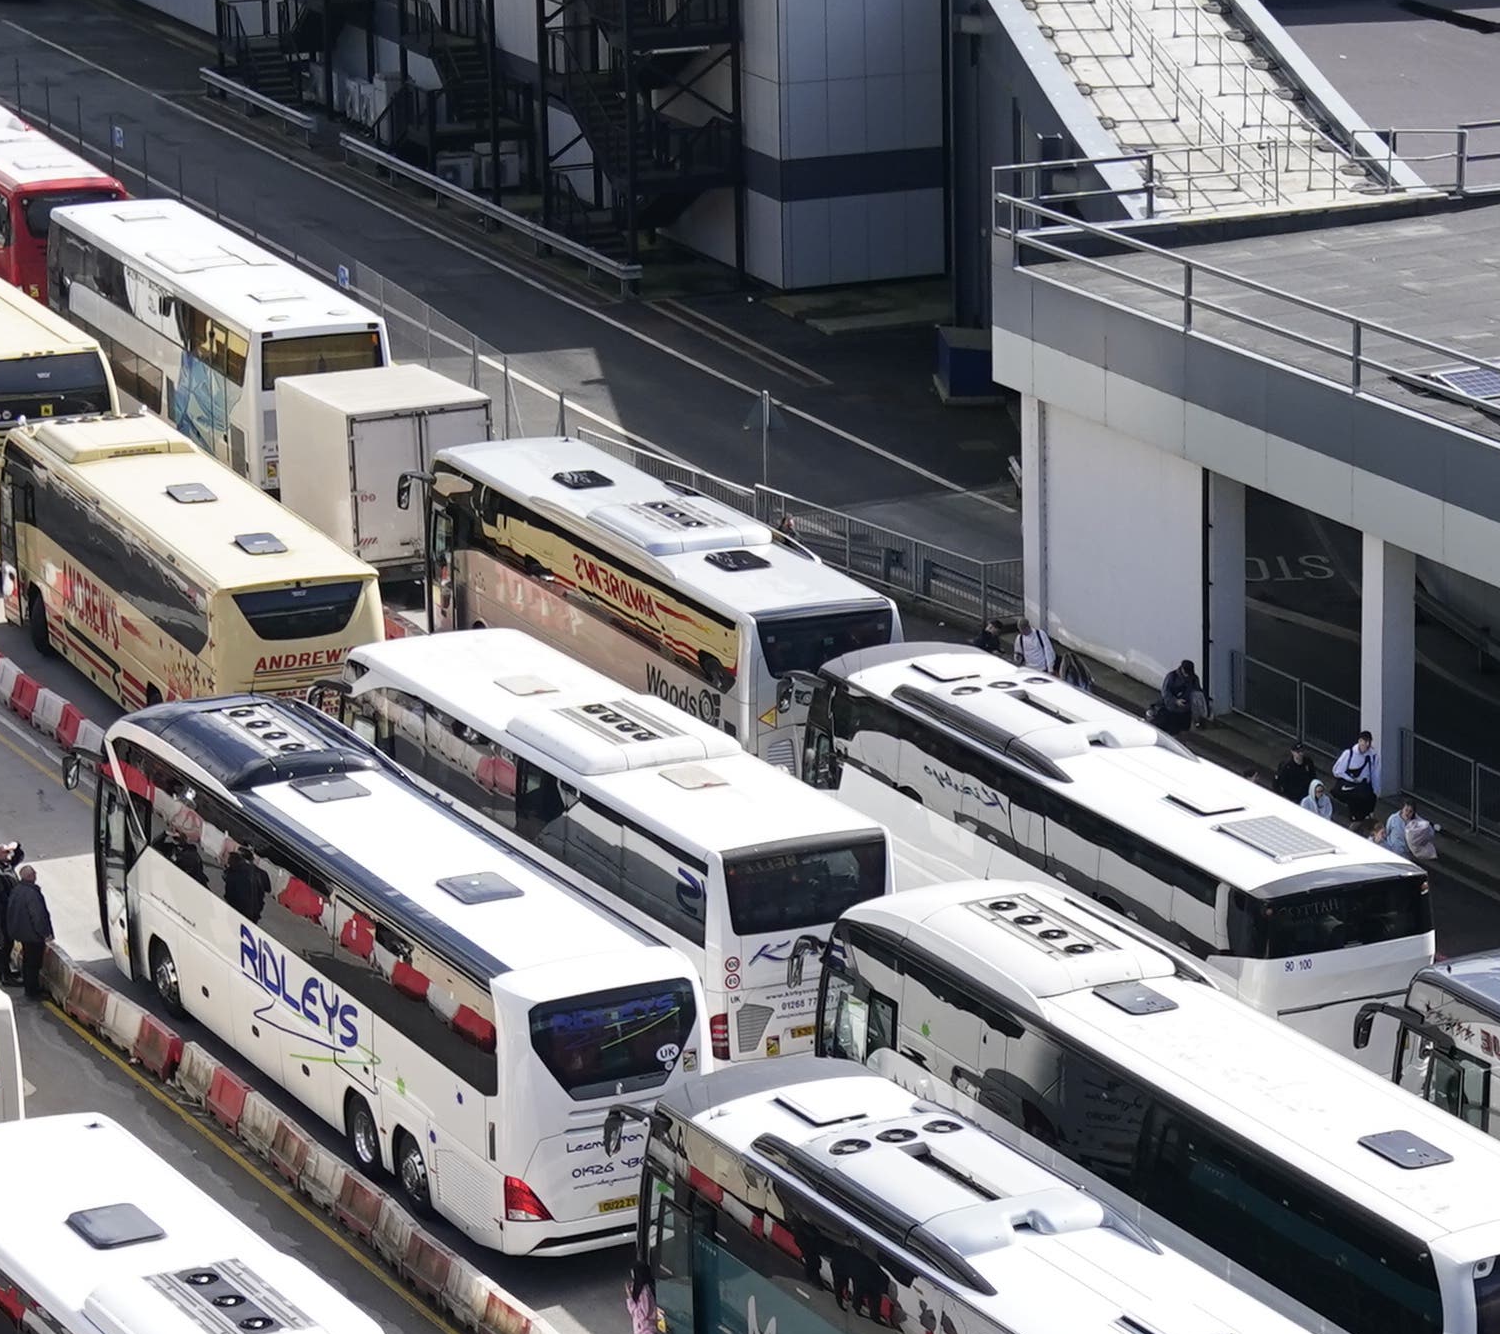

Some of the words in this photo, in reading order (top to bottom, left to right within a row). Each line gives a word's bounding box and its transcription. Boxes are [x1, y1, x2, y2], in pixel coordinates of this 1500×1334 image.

[647, 663, 697, 716] Woods
[1285, 960, 1295, 972] 90
[1299, 958, 1313, 970] 100
[240, 922, 358, 1048] RIDLEYS
[659, 1046, 675, 1059] UK
[572, 1162, 614, 1179] 01926
